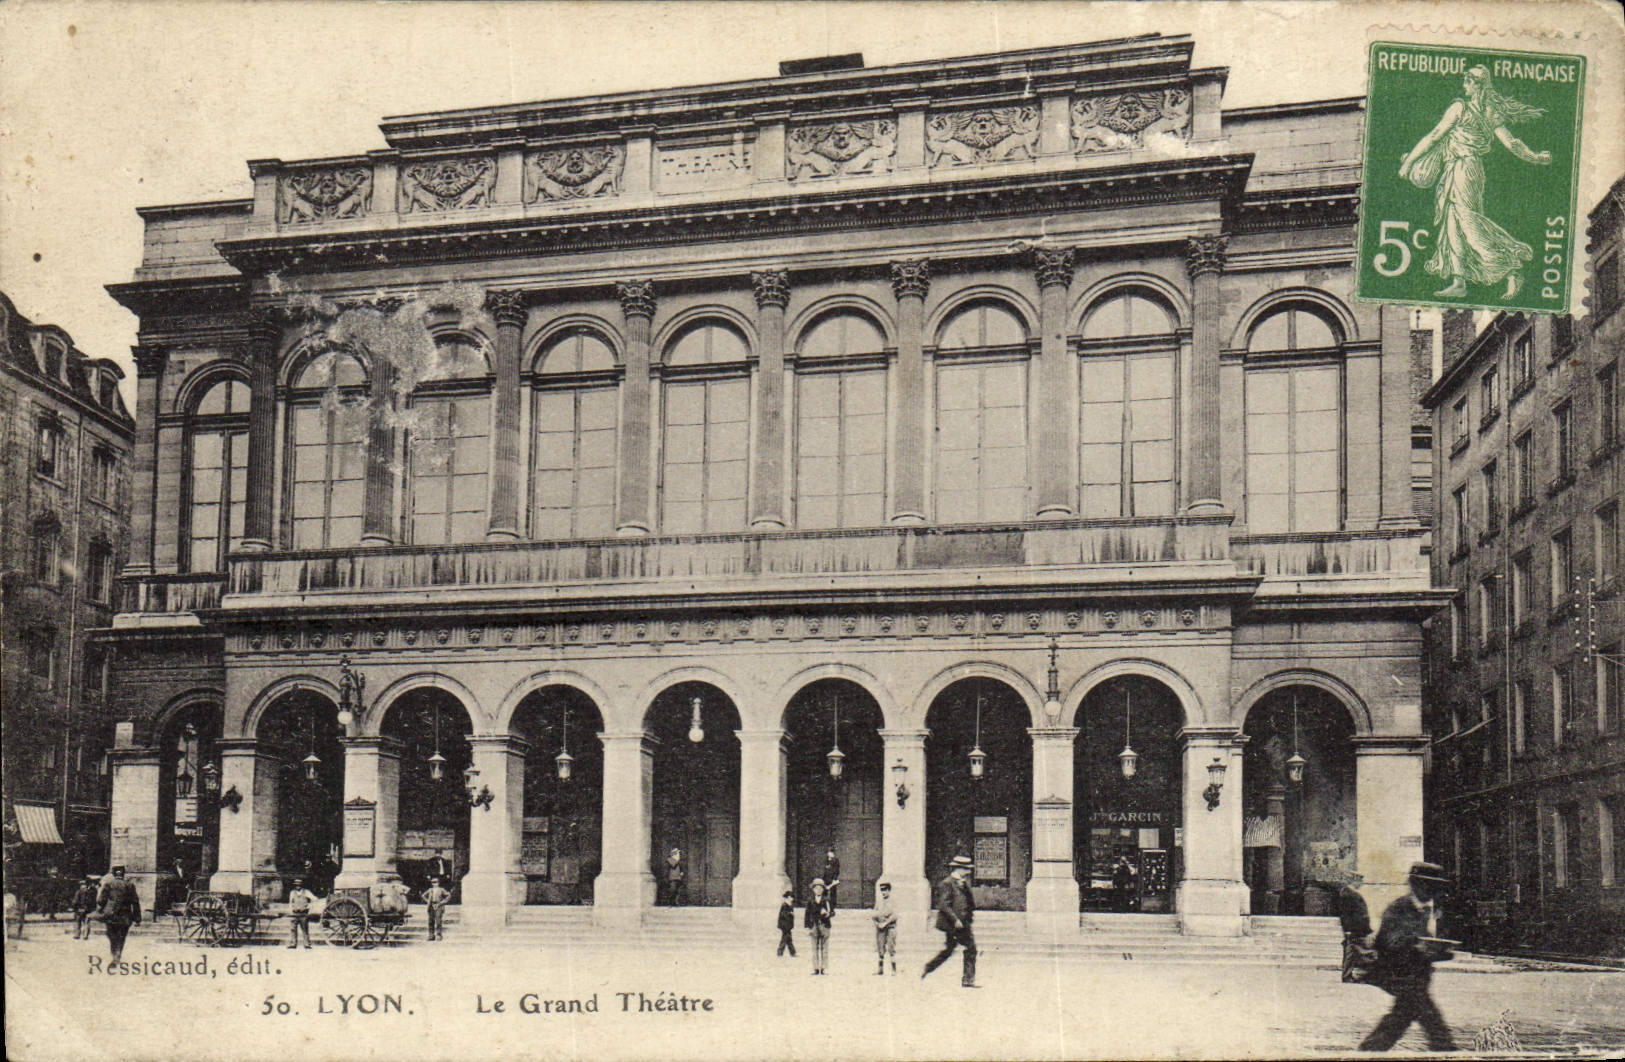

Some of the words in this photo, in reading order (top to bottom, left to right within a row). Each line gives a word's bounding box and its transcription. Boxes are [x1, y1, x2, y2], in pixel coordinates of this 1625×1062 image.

[1378, 51, 1467, 75] REPUBLIQUE
[1494, 60, 1577, 83] FRANÇAISE
[1541, 215, 1565, 299] POSTES
